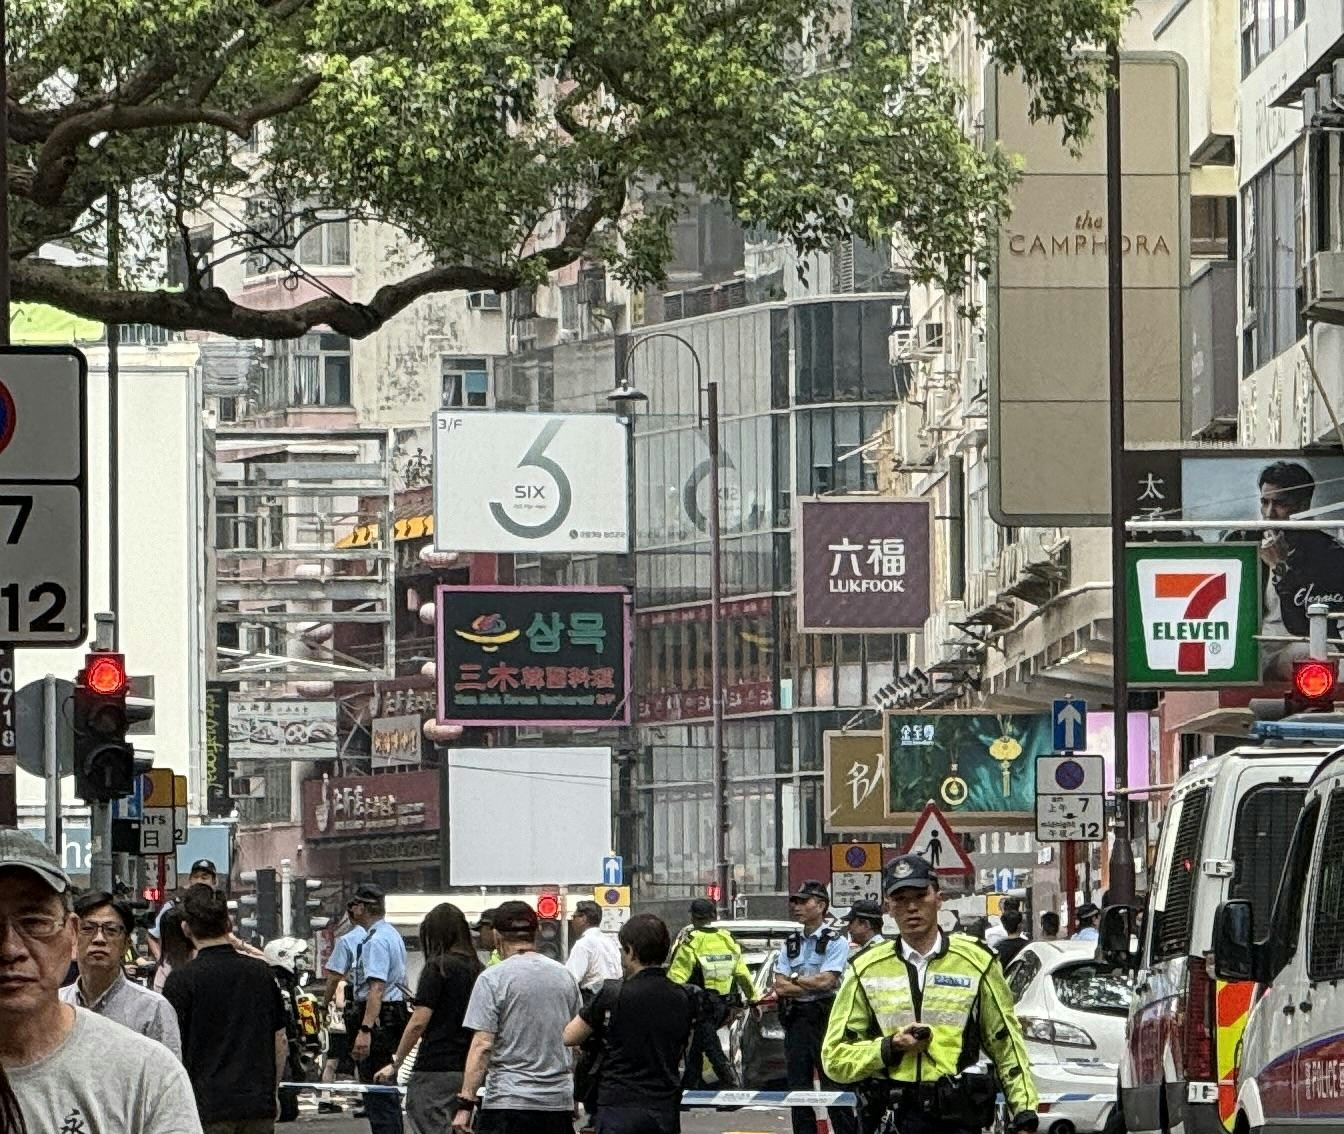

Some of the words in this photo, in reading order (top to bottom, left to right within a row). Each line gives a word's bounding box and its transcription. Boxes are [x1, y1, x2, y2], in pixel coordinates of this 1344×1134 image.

[515, 485, 545, 499] SIX
[6, 496, 34, 545] 7
[829, 538, 905, 577] 六福
[829, 579, 905, 592] LUKFOOK
[0, 582, 67, 633] 12
[1078, 798, 1089, 812] 7
[1080, 823, 1099, 837] 12
